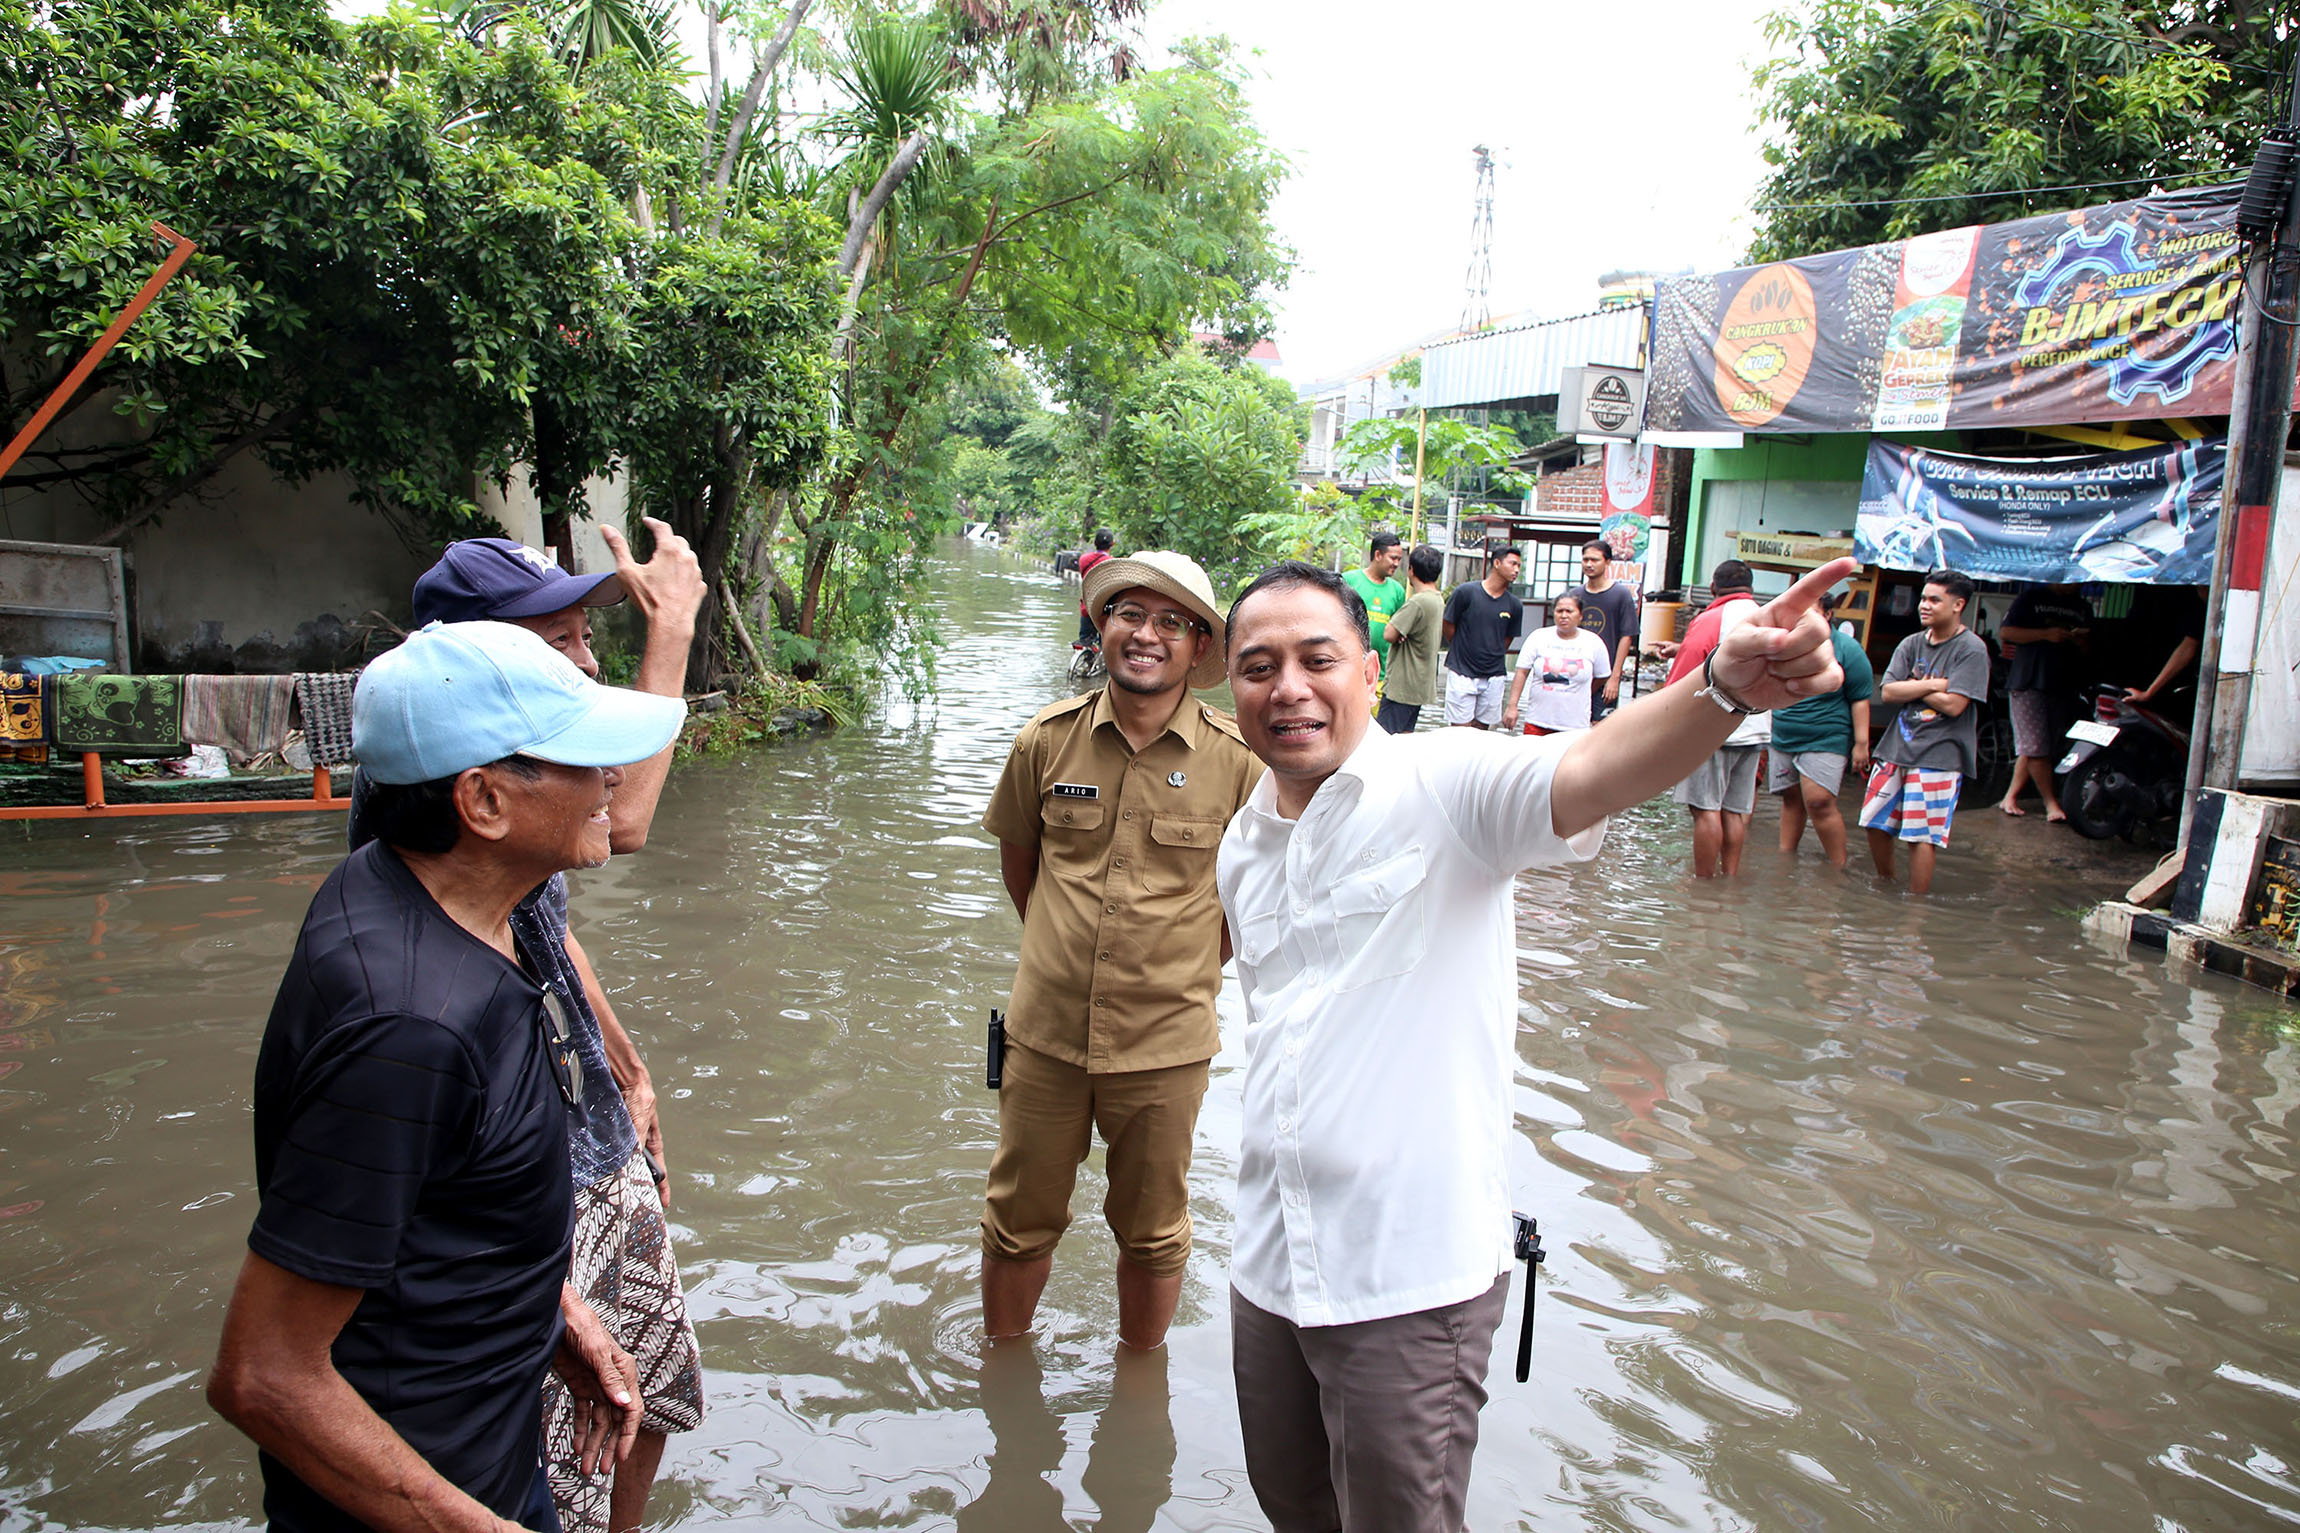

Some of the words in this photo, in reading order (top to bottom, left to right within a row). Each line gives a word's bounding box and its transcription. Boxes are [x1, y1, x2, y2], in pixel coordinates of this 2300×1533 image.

[2158, 229, 2240, 256] MOTORC
[2105, 267, 2173, 291] SERVICE
[2173, 265, 2188, 281] &
[2019, 280, 2242, 346] BJMTECH
[1744, 354, 1776, 371] KOPI
[1891, 344, 1955, 371] AYAM
[1883, 371, 1948, 388] GEPREK
[1732, 390, 1775, 412] BJM
[1948, 483, 1999, 500] Service
[2001, 484, 2013, 500] &
[2015, 484, 2071, 505] Remap
[2073, 484, 2111, 501] ECU
[1998, 501, 2027, 510] (HONDA
[2028, 502, 2050, 510] ONLY)
[1784, 544, 1791, 557] &
[1064, 787, 1086, 795] ARIO
